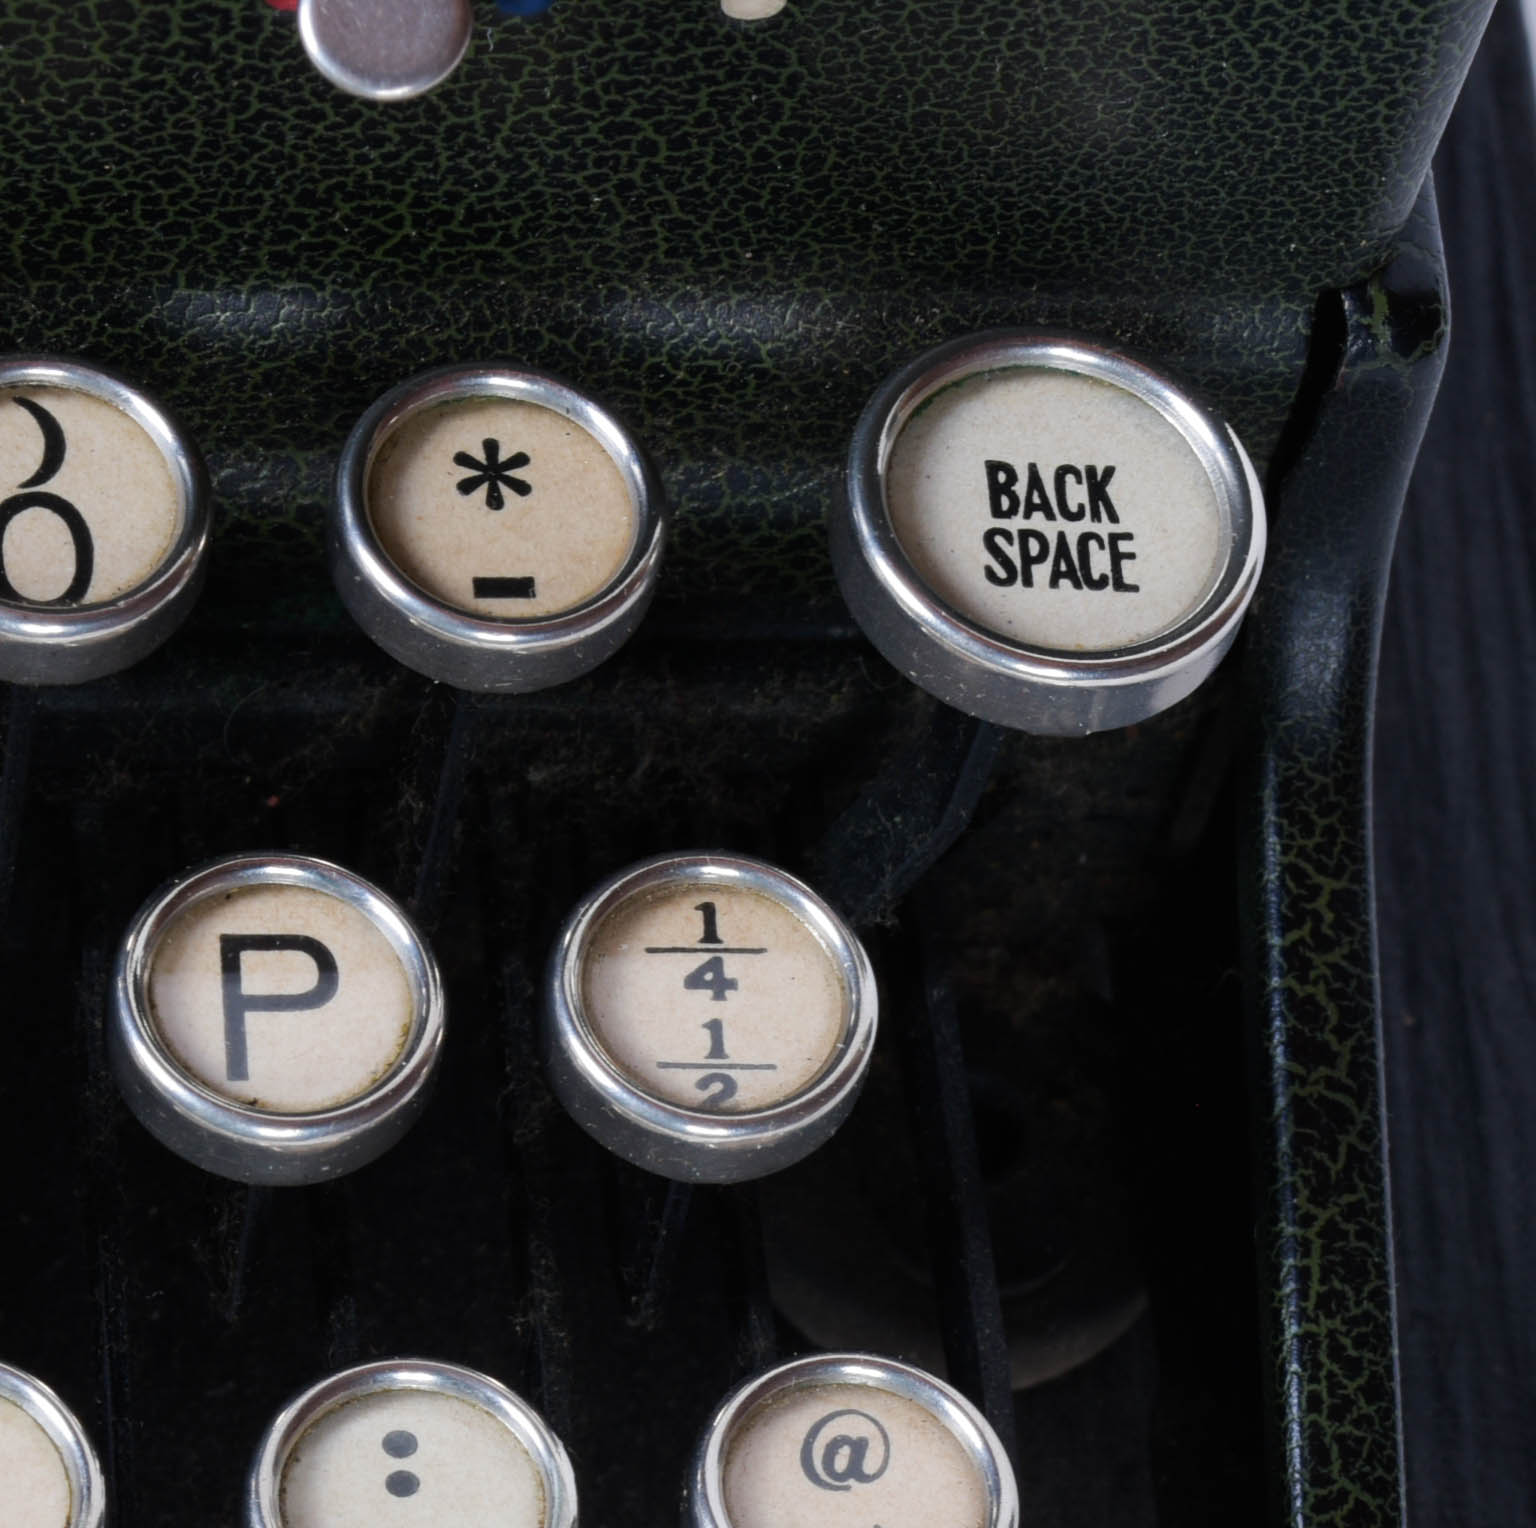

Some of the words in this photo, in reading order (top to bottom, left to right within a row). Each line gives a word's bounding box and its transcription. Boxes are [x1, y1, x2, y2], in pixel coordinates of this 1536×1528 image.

[12, 396, 66, 489] )
[985, 460, 1120, 524] BACK
[983, 527, 1139, 592] SPACE
[219, 934, 338, 1081] P
[800, 1409, 890, 1491] @
